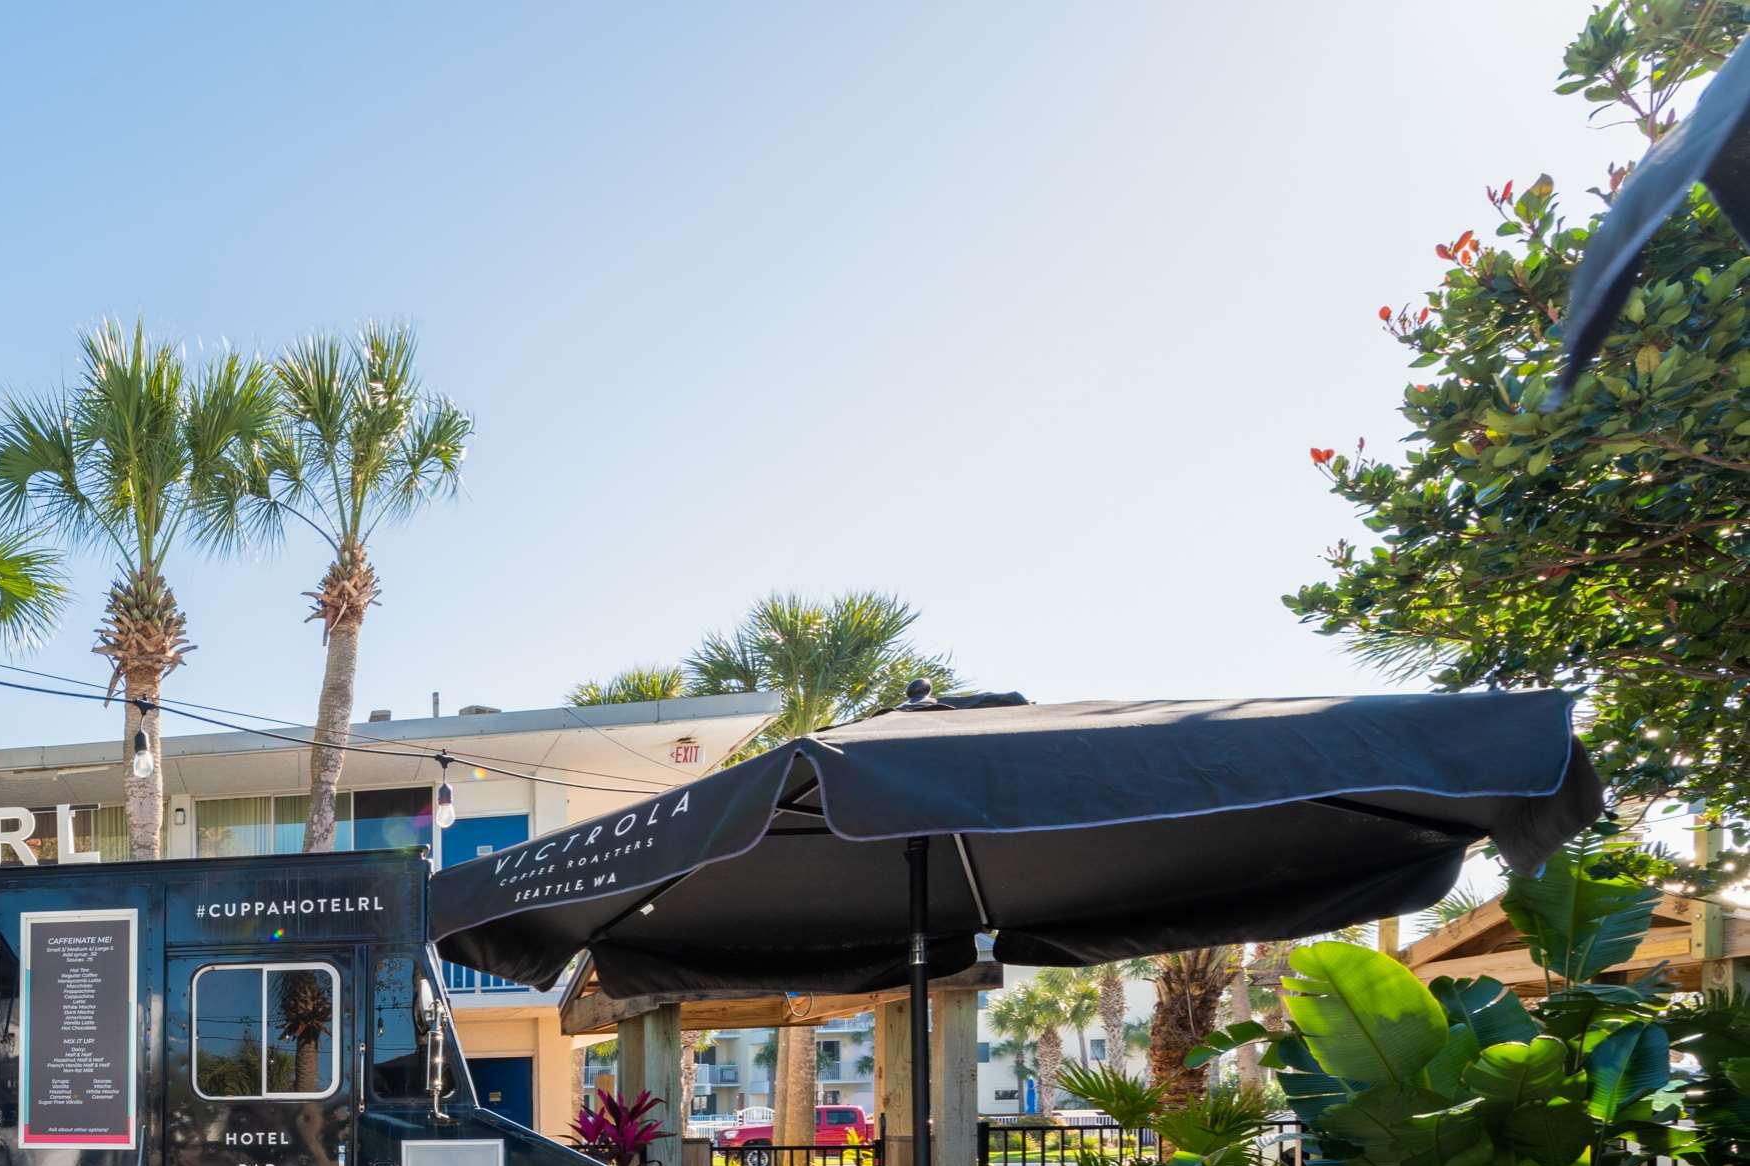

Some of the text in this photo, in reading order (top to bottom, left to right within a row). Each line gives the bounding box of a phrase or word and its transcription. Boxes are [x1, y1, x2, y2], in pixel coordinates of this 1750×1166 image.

[675, 746, 700, 763] EXIT
[494, 790, 690, 875] VICTROLA
[500, 837, 653, 887] COFFEE ROASTERS
[514, 872, 617, 903] SEATTLE, WA
[195, 895, 385, 919] #CUPPAHOTELRL
[48, 936, 96, 945] CAFFEINATE
[225, 1132, 290, 1146] HOTEL
